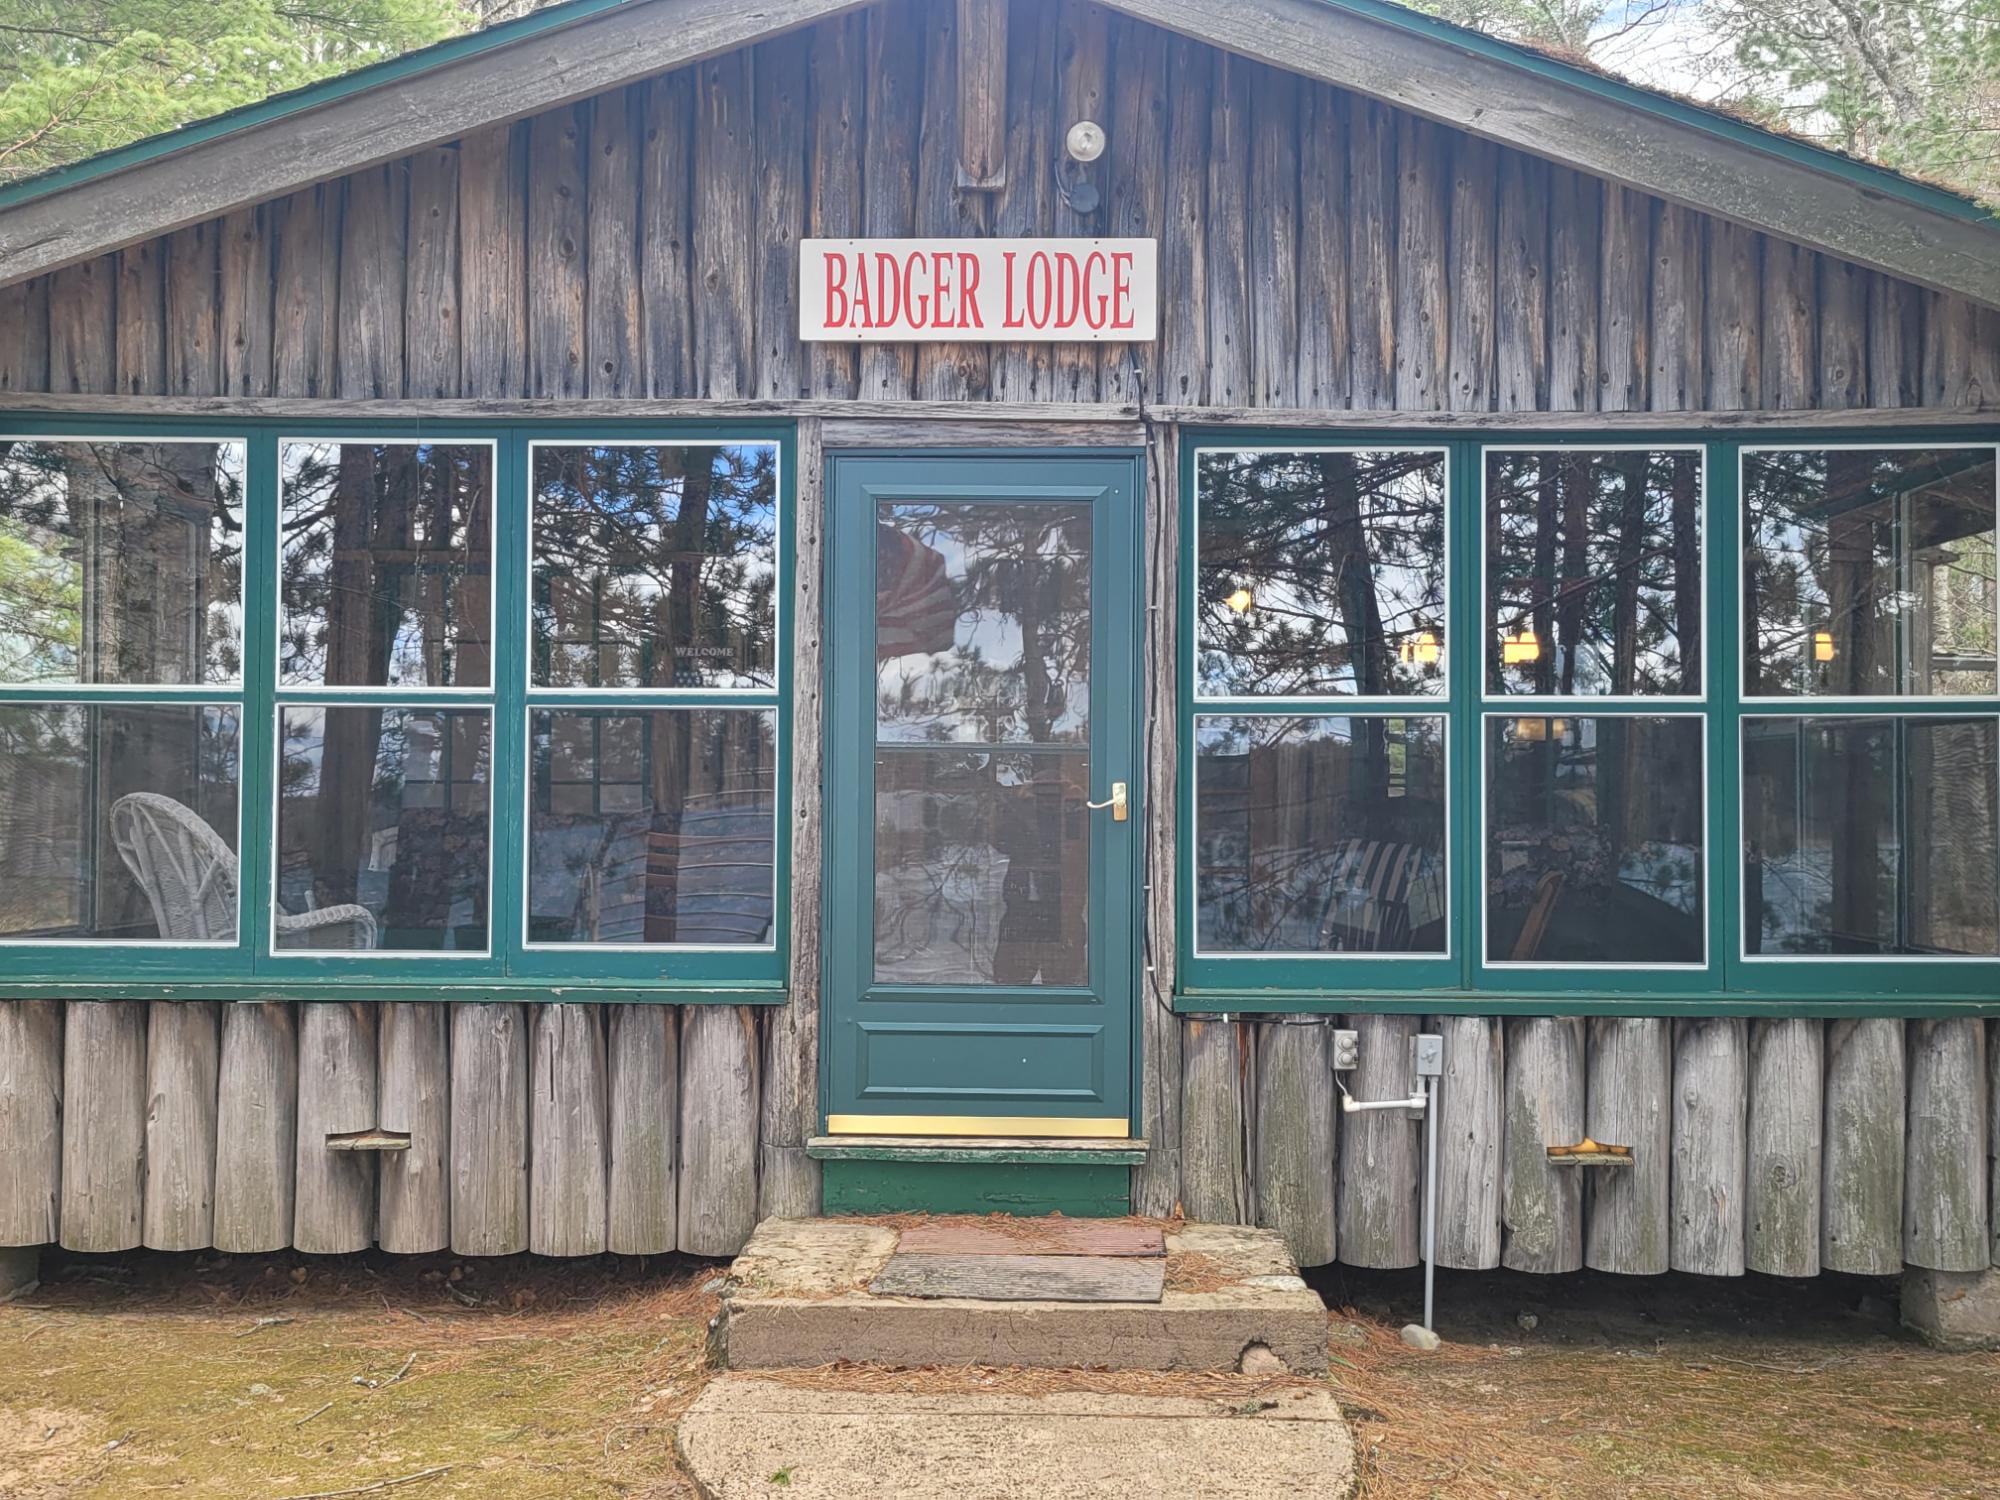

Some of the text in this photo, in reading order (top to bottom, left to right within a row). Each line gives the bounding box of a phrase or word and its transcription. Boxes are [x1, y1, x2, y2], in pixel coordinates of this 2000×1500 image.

[823, 251, 1135, 329] BADGER LODGE
[674, 646, 735, 657] WELCOME
